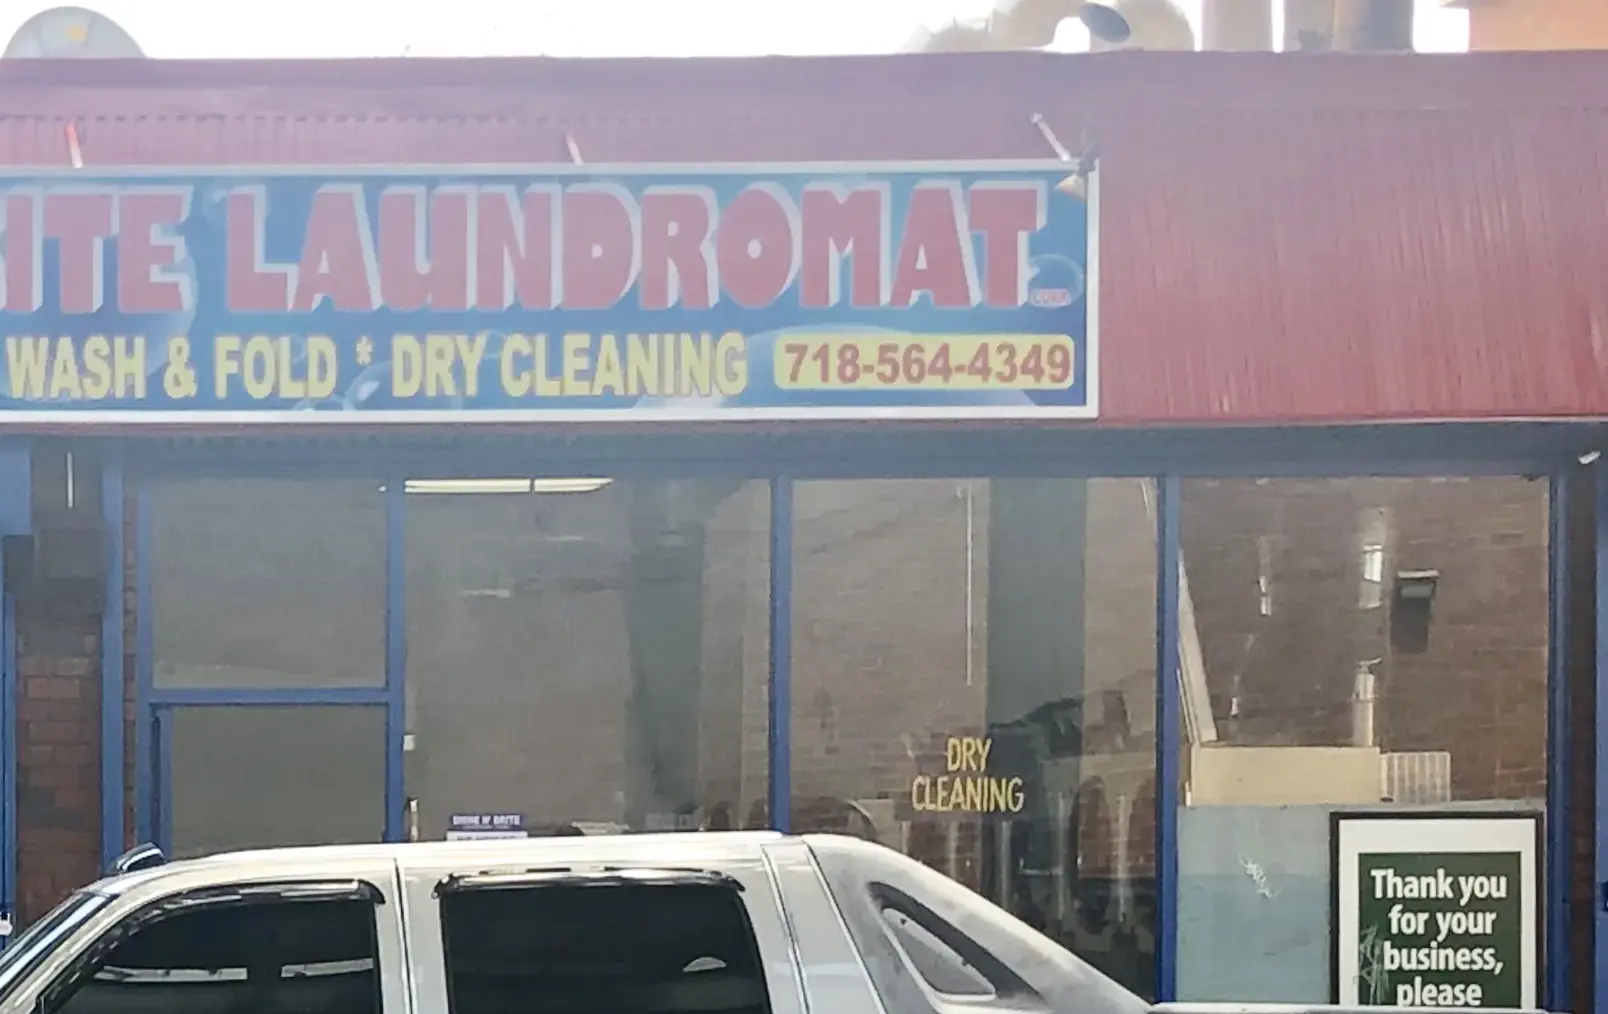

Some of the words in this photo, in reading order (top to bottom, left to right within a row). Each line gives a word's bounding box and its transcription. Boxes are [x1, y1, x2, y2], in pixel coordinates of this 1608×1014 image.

[226, 181, 1048, 313] LAUNDROMAT
[5, 335, 146, 399] WASH
[163, 335, 198, 399] &
[214, 334, 338, 399] FOLD
[392, 333, 487, 397] DRY
[500, 331, 748, 397] CLEANING
[783, 341, 1072, 385] 718-564-4349
[947, 736, 992, 772] DRY
[911, 775, 1025, 813] CLEANING
[1370, 868, 1454, 899] Thank
[1459, 874, 1507, 907] you
[1388, 904, 1429, 935] for
[1436, 911, 1497, 942] your
[1383, 940, 1504, 975] business,
[1396, 976, 1483, 1008] please
